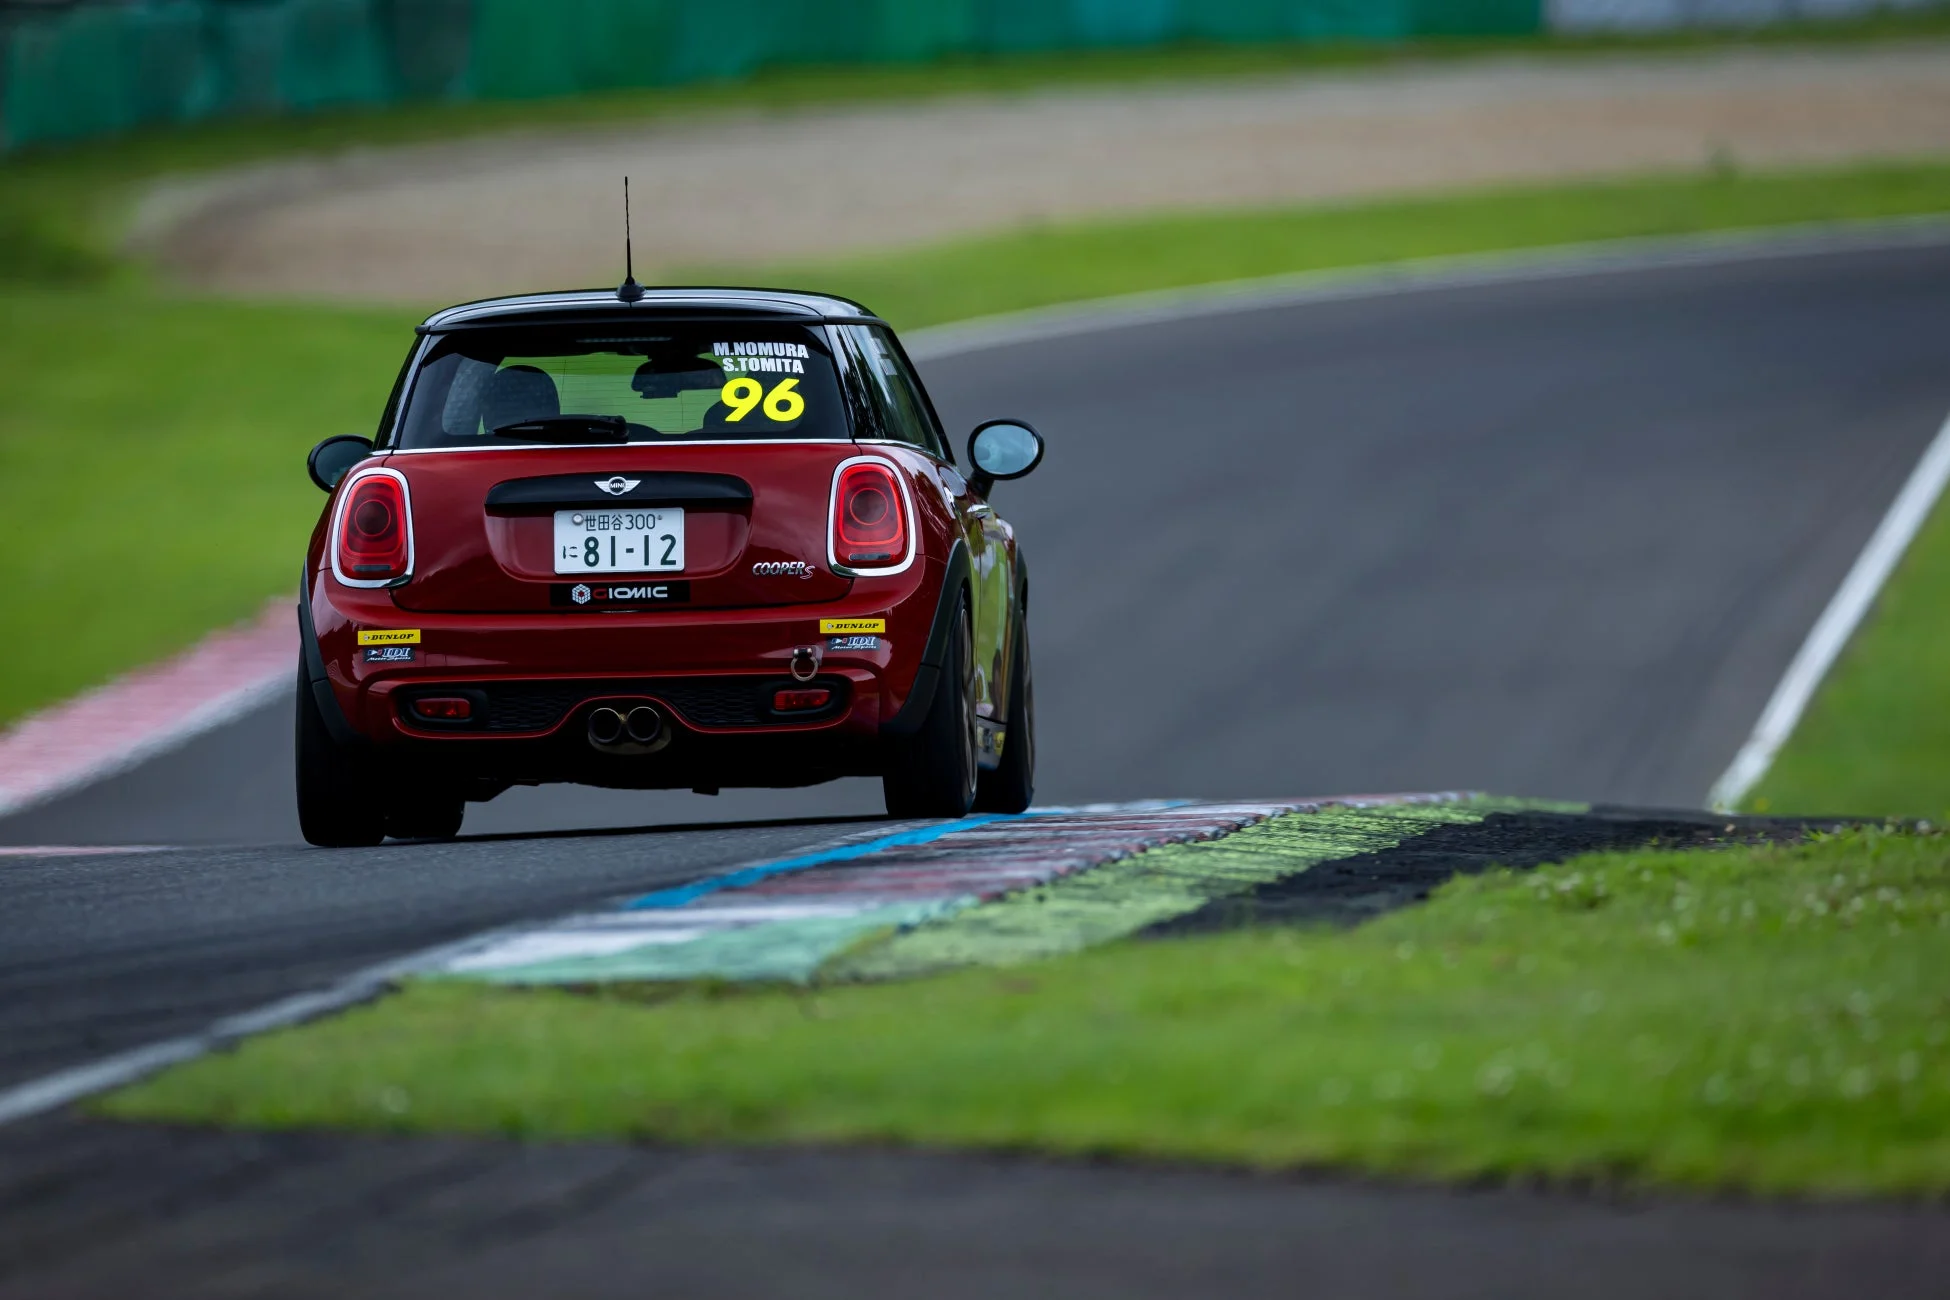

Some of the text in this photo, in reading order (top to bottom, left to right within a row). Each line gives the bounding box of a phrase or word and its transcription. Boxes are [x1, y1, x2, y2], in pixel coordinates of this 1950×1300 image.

[713, 342, 809, 358] M.NOMURA
[722, 357, 804, 373] S.TOMITA
[721, 377, 805, 422] 96
[584, 534, 677, 567] 81-12
[752, 561, 806, 576] COOPER
[592, 586, 668, 599] GIOMIC
[371, 633, 414, 641] DUNLOP
